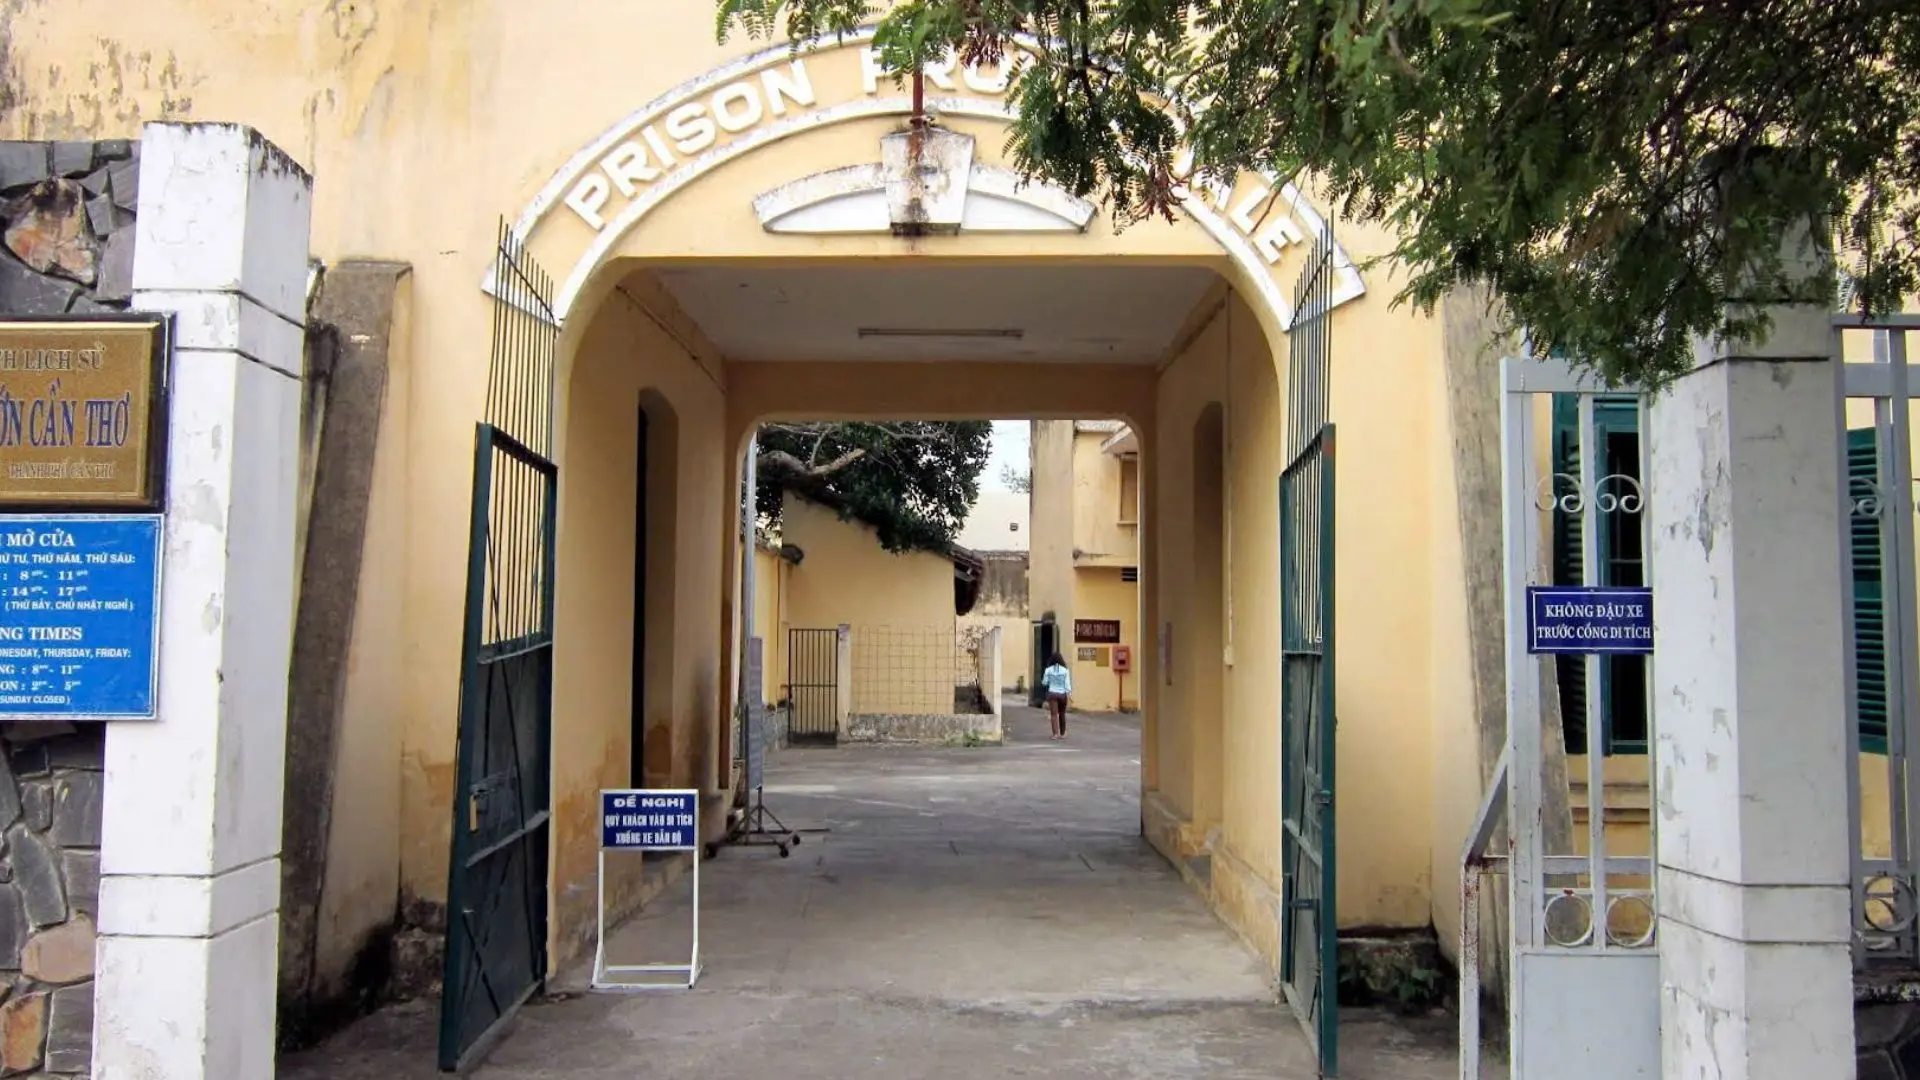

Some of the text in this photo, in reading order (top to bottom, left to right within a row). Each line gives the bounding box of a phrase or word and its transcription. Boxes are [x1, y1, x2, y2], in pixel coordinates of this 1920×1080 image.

[564, 59, 816, 230] PRISON
[85, 391, 131, 446] THƠ
[39, 528, 76, 547] CỬA
[1545, 602, 1644, 620] KHÔNG ĐẬU XE
[28, 627, 82, 640] TIMES
[1537, 624, 1575, 638] TRƯỚC
[1610, 627, 1622, 638] DI
[1623, 624, 1651, 638] TÍCH
[43, 648, 94, 659] THURSDAY,
[95, 648, 131, 658] FRIDAY:
[641, 797, 684, 809] NGHỊ
[622, 812, 647, 826] KHÁCH
[642, 833, 653, 844] XE
